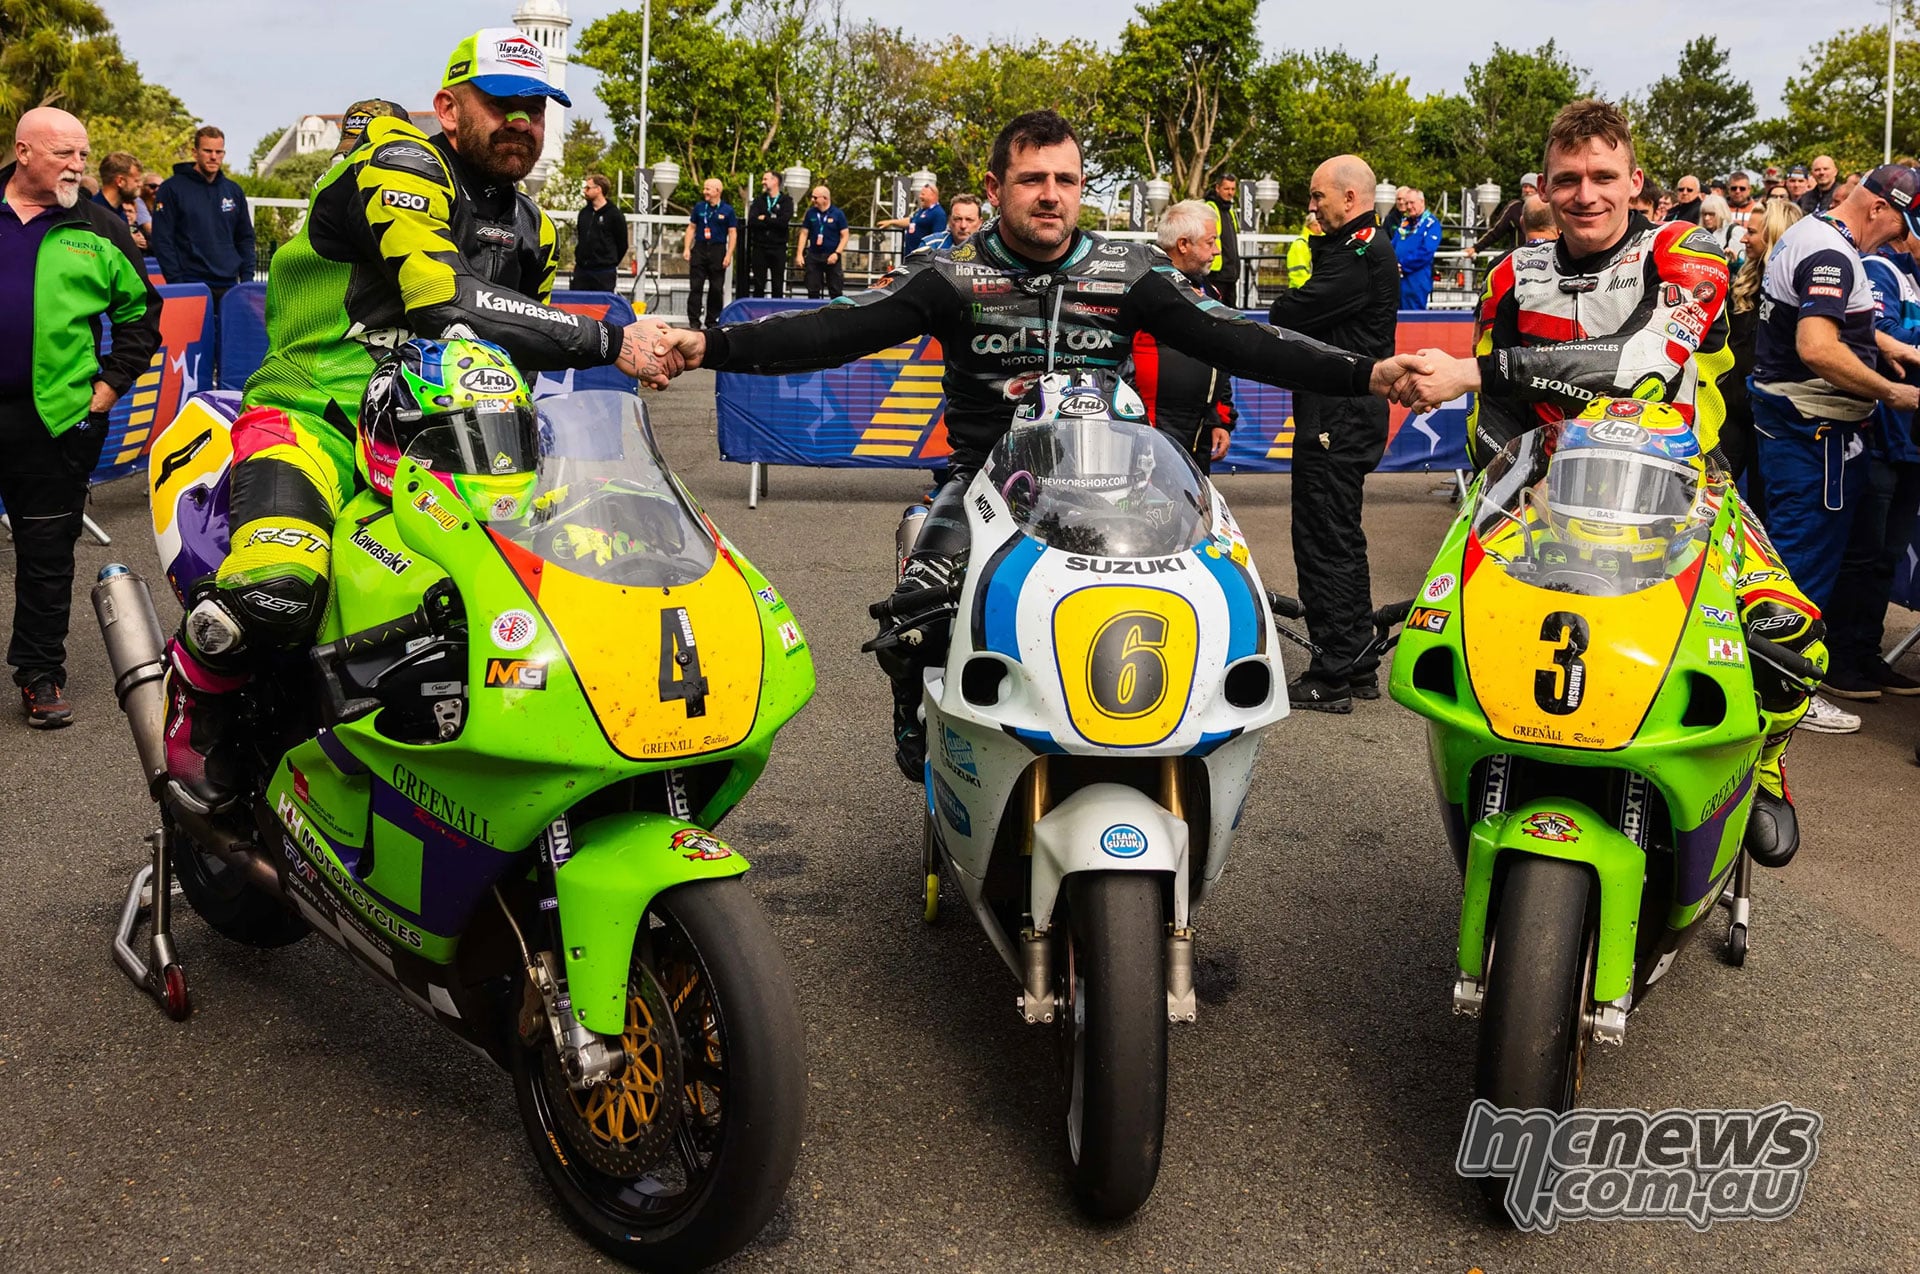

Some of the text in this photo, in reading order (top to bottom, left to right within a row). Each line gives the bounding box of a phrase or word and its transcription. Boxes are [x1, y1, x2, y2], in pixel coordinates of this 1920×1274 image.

[476, 226, 515, 240] RST
[59, 238, 105, 252] GREENALL
[1605, 277, 1639, 292] Mum
[1809, 286, 1842, 297] MOTUL
[476, 290, 579, 327] Kawasaki
[970, 327, 1114, 355] carl cox
[1555, 343, 1619, 352] MOTORCYCLES
[1001, 354, 1087, 367] MOTORPORT
[466, 371, 511, 386] Arai
[1530, 375, 1596, 401] HOND
[1063, 397, 1102, 410] Arai
[1595, 420, 1647, 438] Arai
[1037, 476, 1128, 488] THEVISORSHOP.COM
[974, 494, 997, 524] MOTUL
[244, 527, 331, 553] RST
[350, 526, 412, 575] Kawasaki
[1064, 556, 1188, 575] SUZUKI
[1736, 570, 1791, 589] RST
[243, 590, 308, 614] RST
[676, 608, 696, 647] COWARD
[1408, 608, 1451, 631] MG
[1750, 613, 1804, 633] RST
[487, 659, 544, 686] MG
[658, 606, 709, 719] 4
[1085, 610, 1169, 721] 6
[1534, 610, 1591, 716] 3
[1707, 659, 1745, 669] MOTORCYCLES
[1566, 664, 1583, 708] HARRISON
[642, 735, 730, 755] GREENALL Racing
[1513, 725, 1605, 746] GREENALL Racing
[392, 763, 496, 846] GREENALL
[1107, 838, 1142, 849] SUZUKI
[1110, 832, 1137, 841] TEAM
[302, 827, 423, 950] MOTORCYCLES
